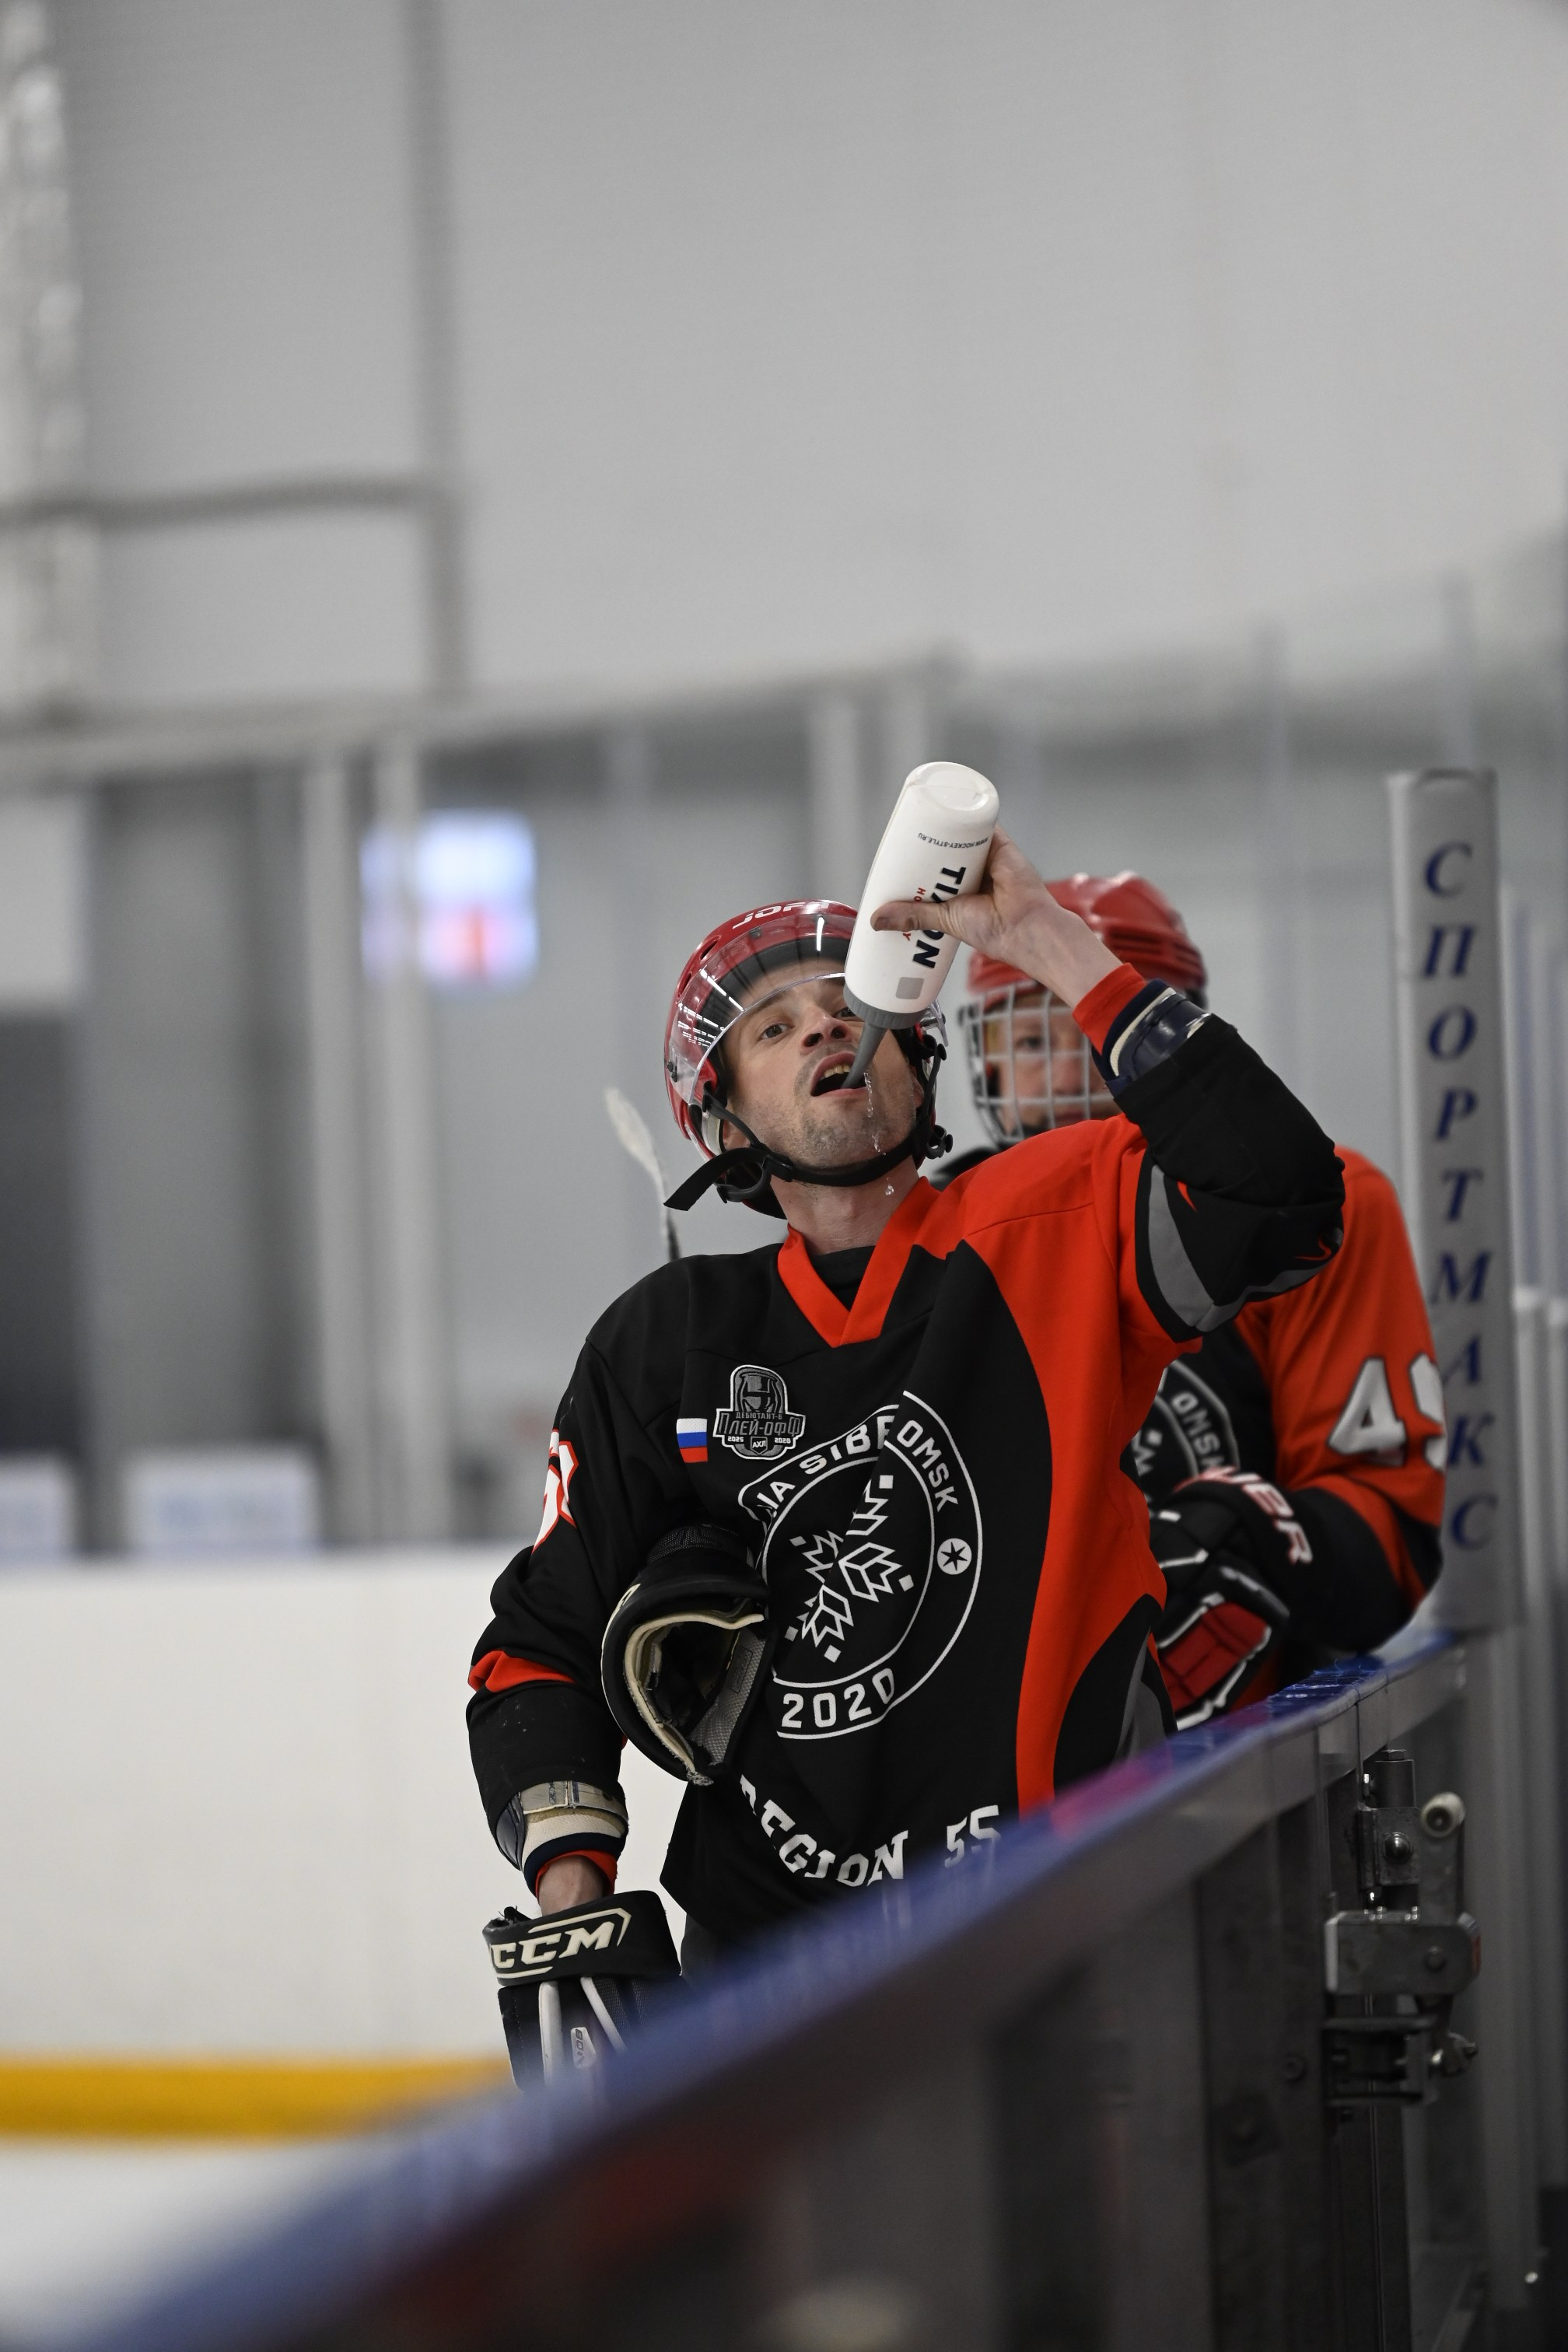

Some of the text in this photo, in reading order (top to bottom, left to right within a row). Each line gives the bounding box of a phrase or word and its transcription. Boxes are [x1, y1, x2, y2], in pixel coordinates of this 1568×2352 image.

[912, 866, 967, 969] TIN
[1423, 840, 1498, 1551] СПОРТМАКС
[718, 1412, 800, 1437] ПЛЕЙ-ОФФ
[752, 1440, 767, 1448] АХЛ
[897, 1419, 959, 1512] OMSK
[781, 1668, 895, 1729] 2020
[490, 1920, 615, 1969] CCM
